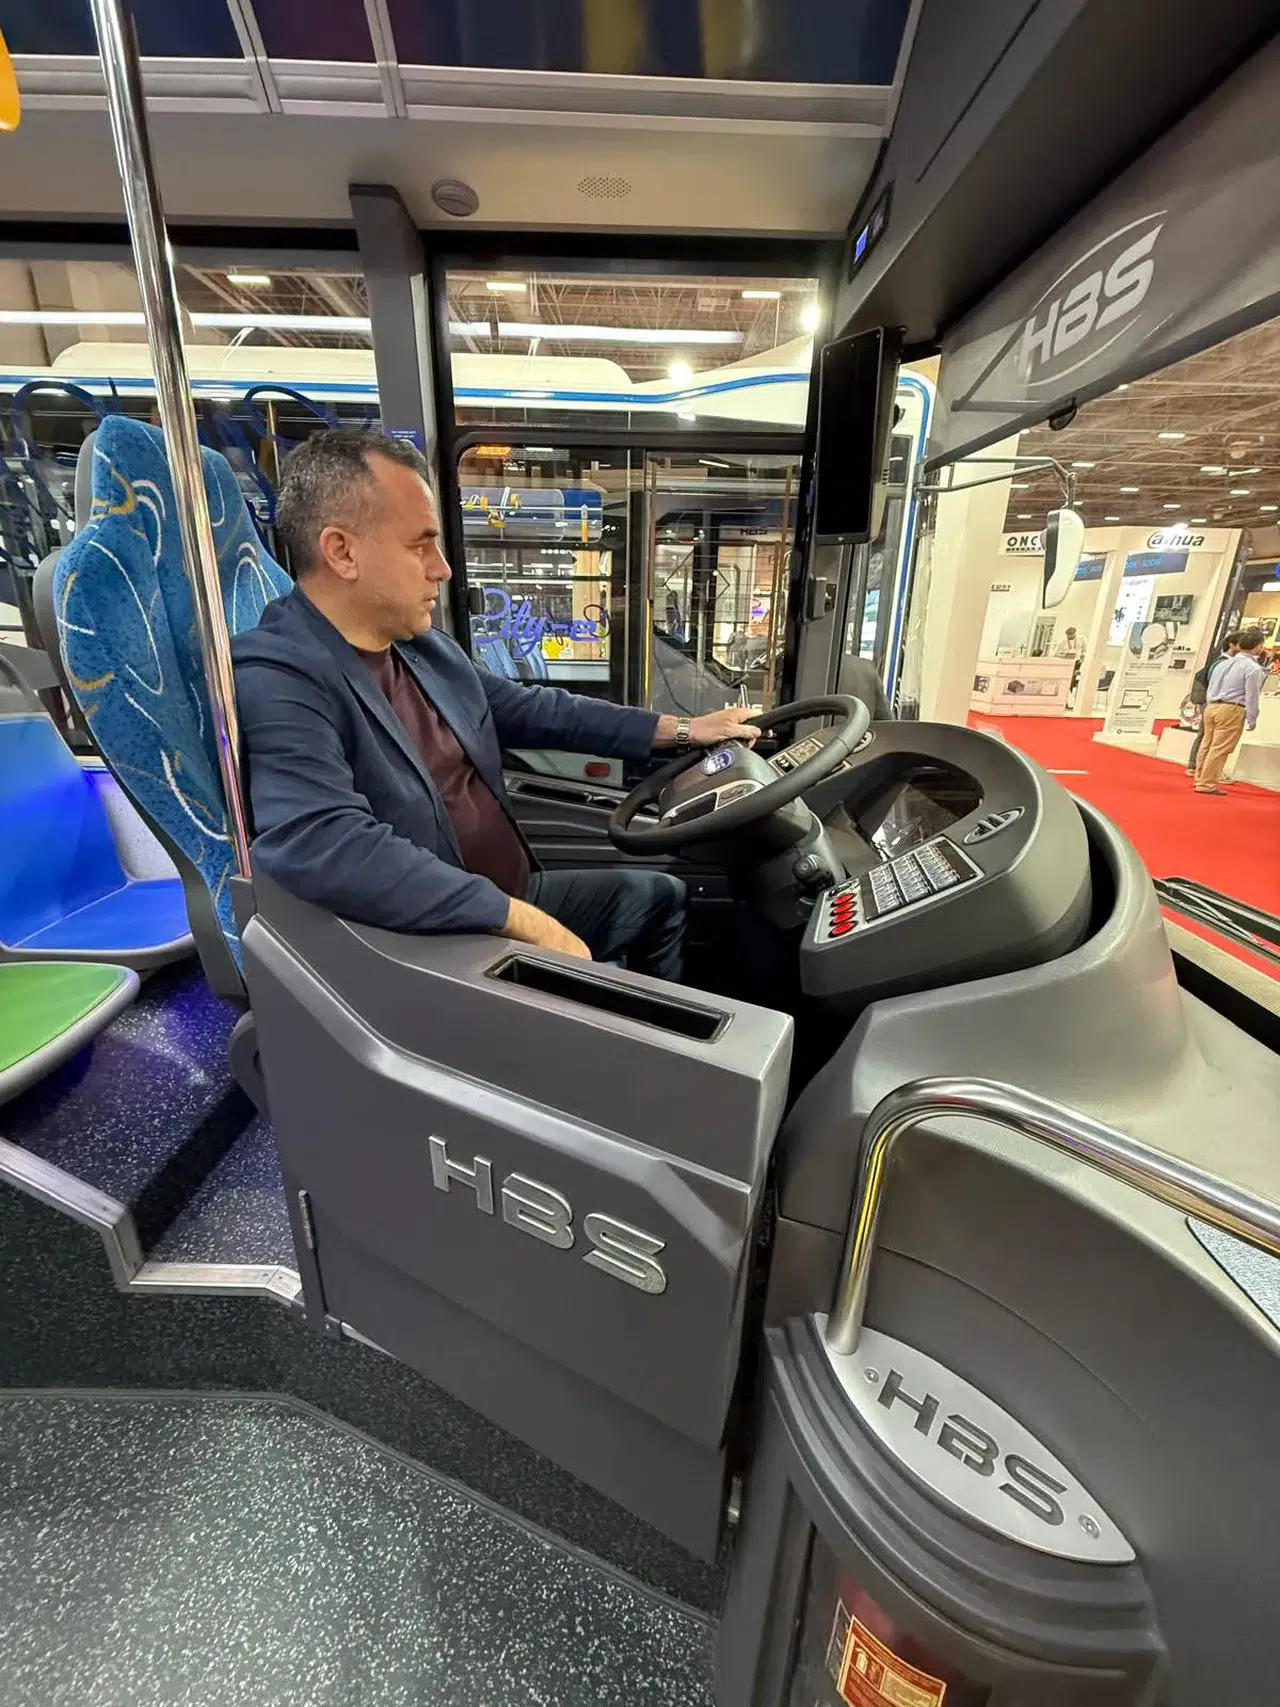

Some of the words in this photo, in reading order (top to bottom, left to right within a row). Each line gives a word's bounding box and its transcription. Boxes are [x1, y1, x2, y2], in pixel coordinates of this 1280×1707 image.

[1020, 222, 1164, 371] HBS
[428, 1133, 667, 1294] HBS
[877, 1369, 1068, 1526] HBS
